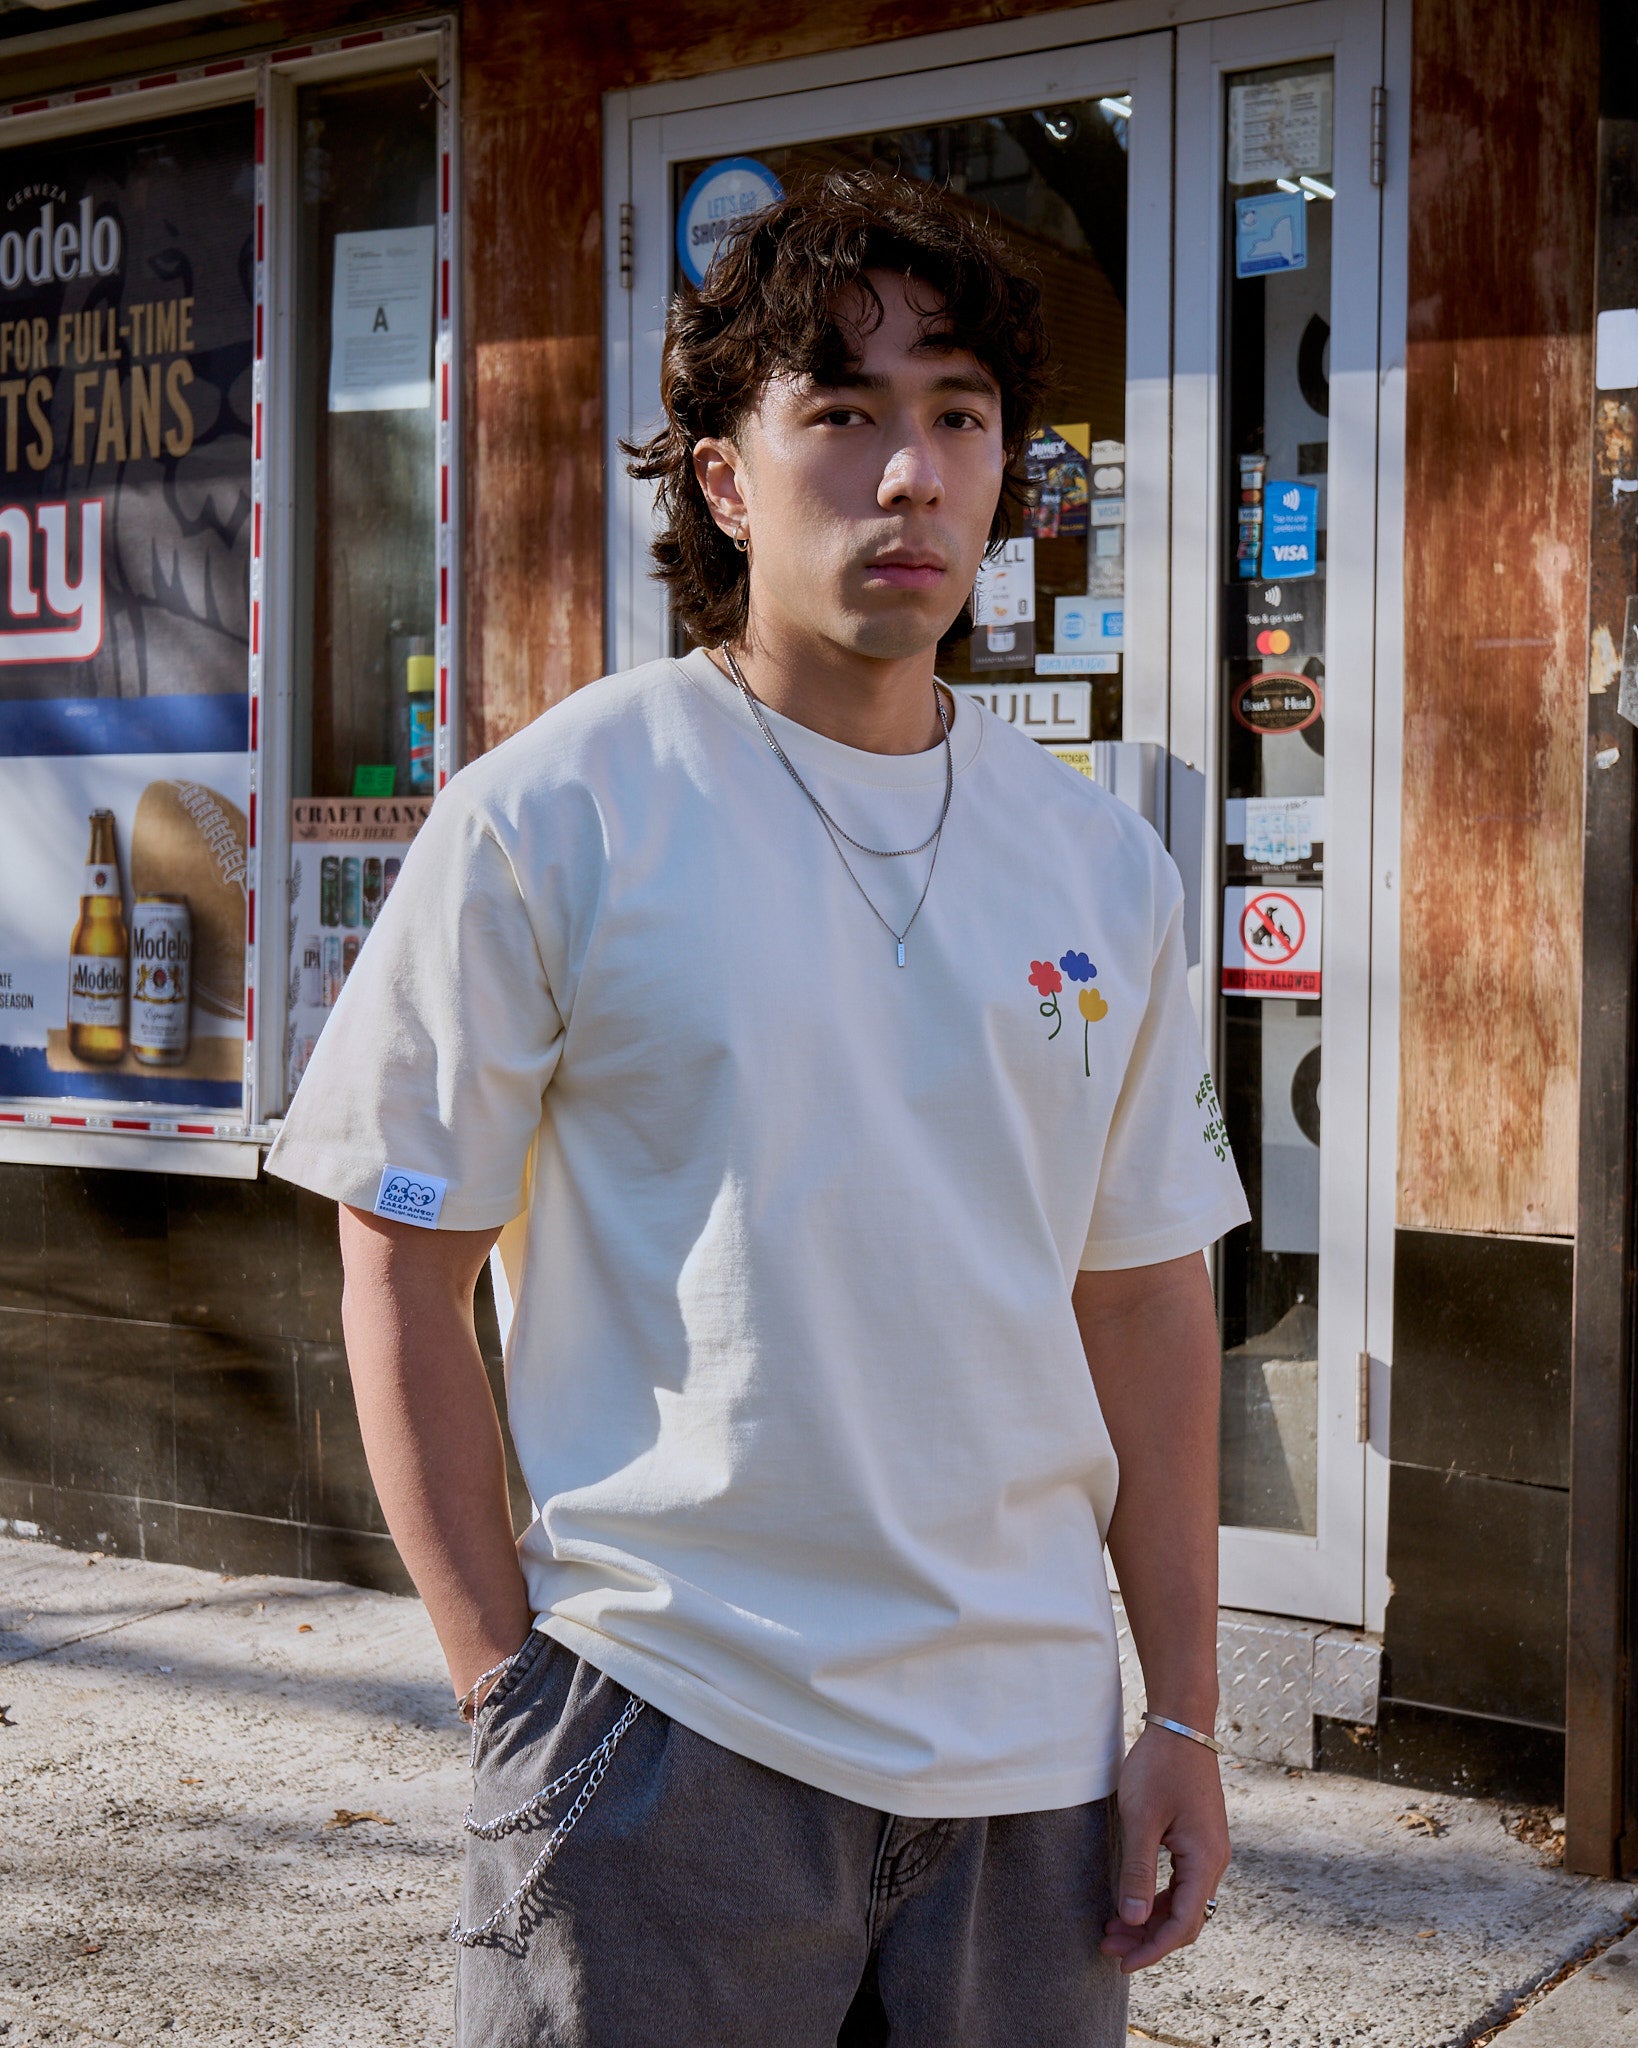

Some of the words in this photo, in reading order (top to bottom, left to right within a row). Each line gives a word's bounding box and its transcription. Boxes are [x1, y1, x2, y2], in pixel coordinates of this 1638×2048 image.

[7, 183, 67, 212] CERVEZA
[0, 195, 120, 290] odelo
[372, 306, 389, 333] A
[0, 317, 49, 374] FOR
[58, 297, 195, 366] FULL-TIME
[0, 375, 54, 472] TS
[73, 358, 195, 466] FANS
[1272, 544, 1309, 562] VISA
[1247, 613, 1261, 626] Tap
[1261, 613, 1269, 624] &
[1269, 615, 1282, 626] go
[1283, 612, 1304, 623] with
[970, 693, 1075, 724] ULL
[1284, 695, 1312, 710] Head
[294, 805, 365, 824] CRAFT
[133, 926, 189, 961] Modelo
[78, 963, 123, 990] Modelo
[1242, 971, 1266, 988] PETS
[1269, 973, 1316, 990] ALLOWED
[1207, 1096, 1217, 1118] IT
